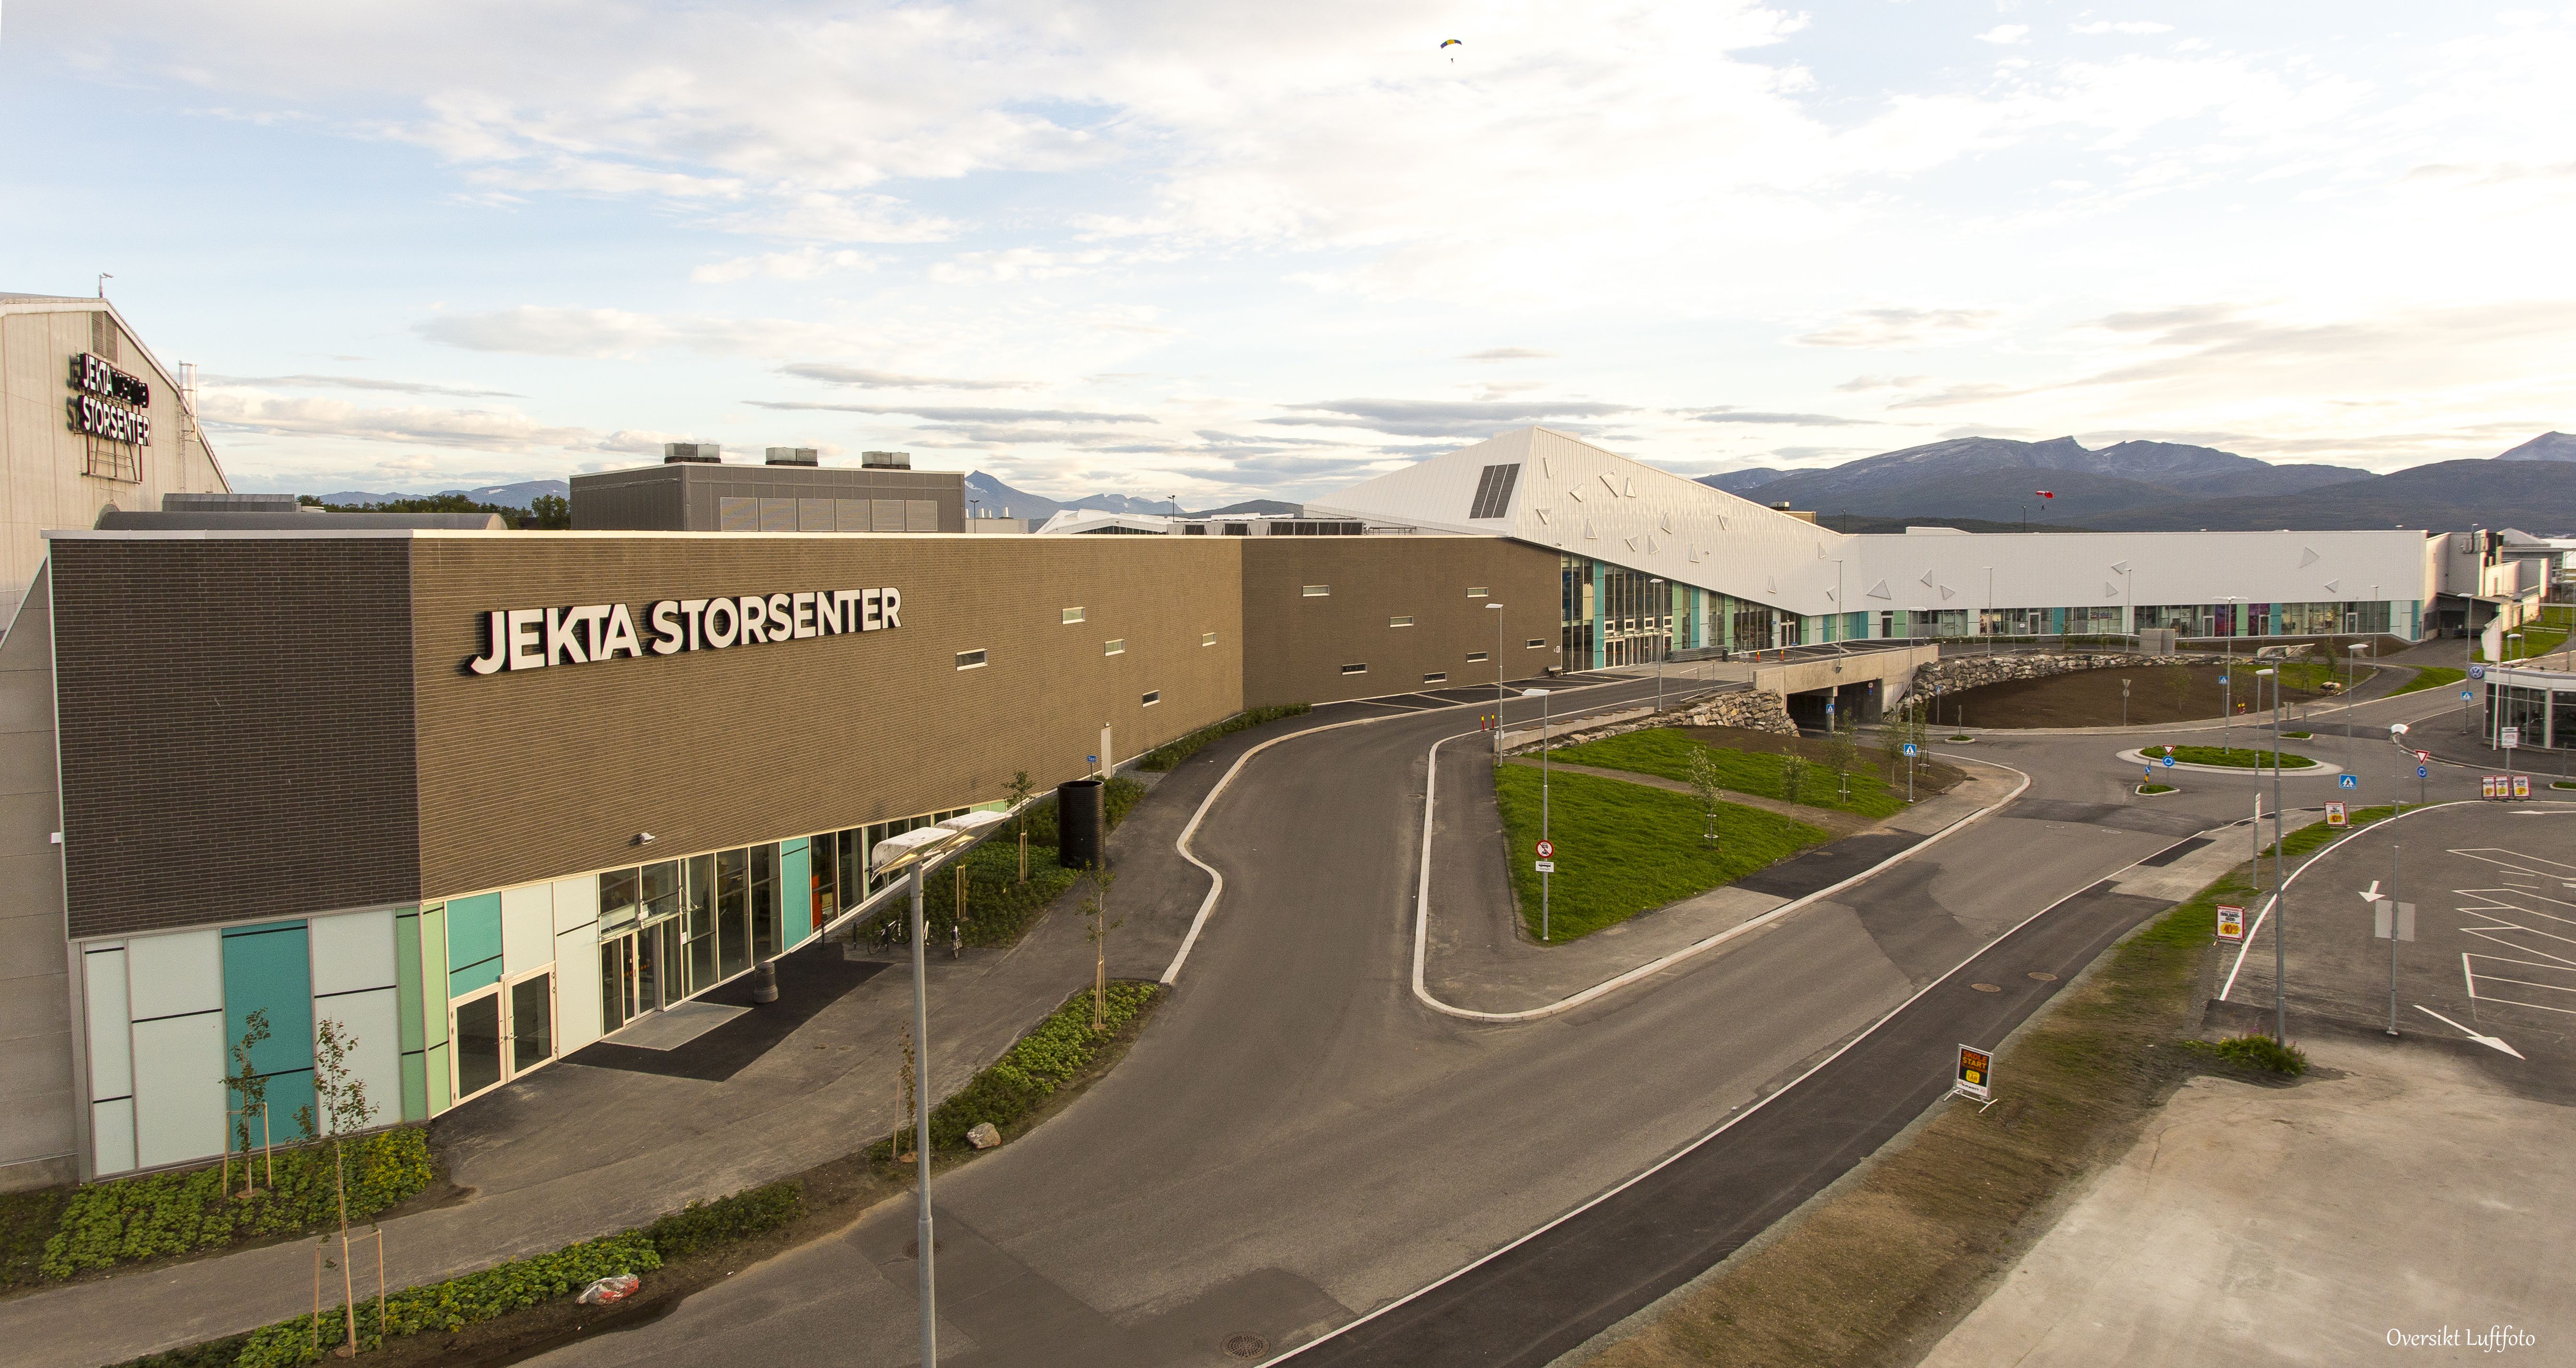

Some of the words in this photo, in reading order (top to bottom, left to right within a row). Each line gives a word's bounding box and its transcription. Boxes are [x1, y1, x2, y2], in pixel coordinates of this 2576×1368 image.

[82, 354, 114, 397] JEKTA
[82, 395, 151, 447] STORSENTER
[470, 603, 643, 675] JEKTA
[651, 586, 902, 655] STORSENTER
[1962, 1057, 1988, 1069] START
[1963, 1050, 1988, 1063] SKOLE
